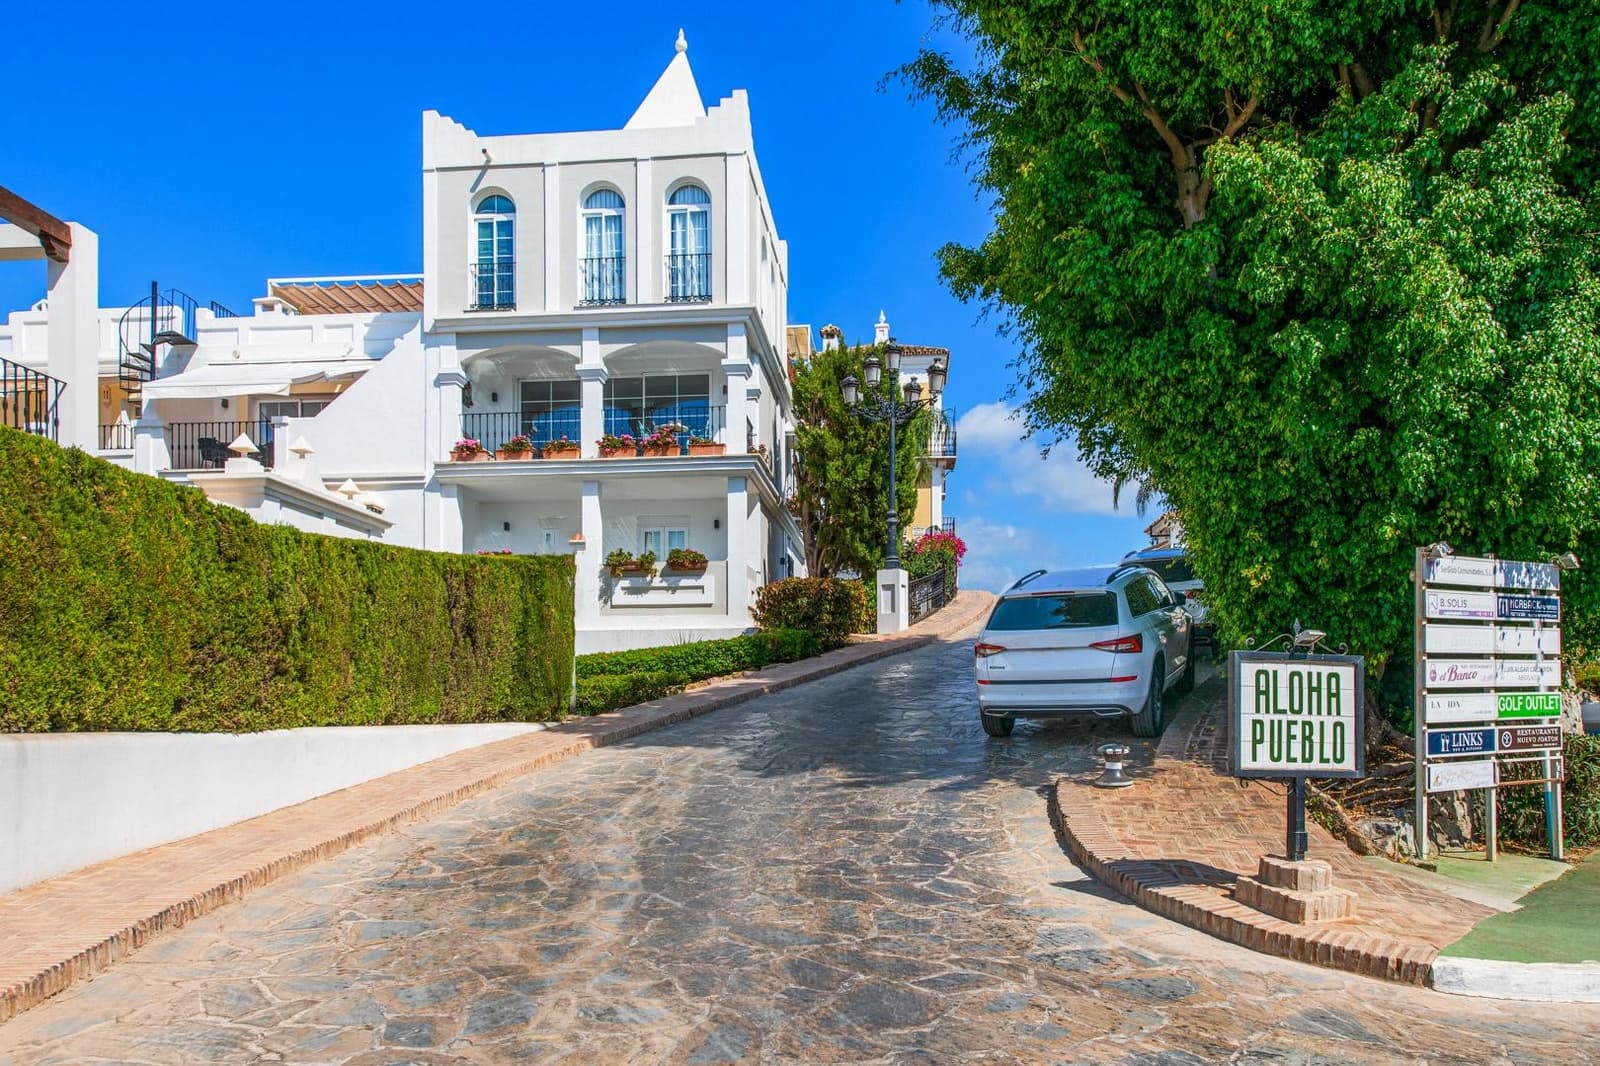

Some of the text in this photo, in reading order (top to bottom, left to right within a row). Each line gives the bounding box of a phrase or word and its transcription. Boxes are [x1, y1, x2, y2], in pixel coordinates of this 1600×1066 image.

[1447, 664, 1478, 681] Banco
[1254, 669, 1341, 716] ALOHA
[1498, 695, 1560, 712] GOLF OUTLET
[1451, 731, 1483, 747] LINKS
[1517, 728, 1559, 736] RESTAURANTE
[1517, 736, 1537, 744] NUEVO
[1251, 719, 1345, 764] PUEBLO
